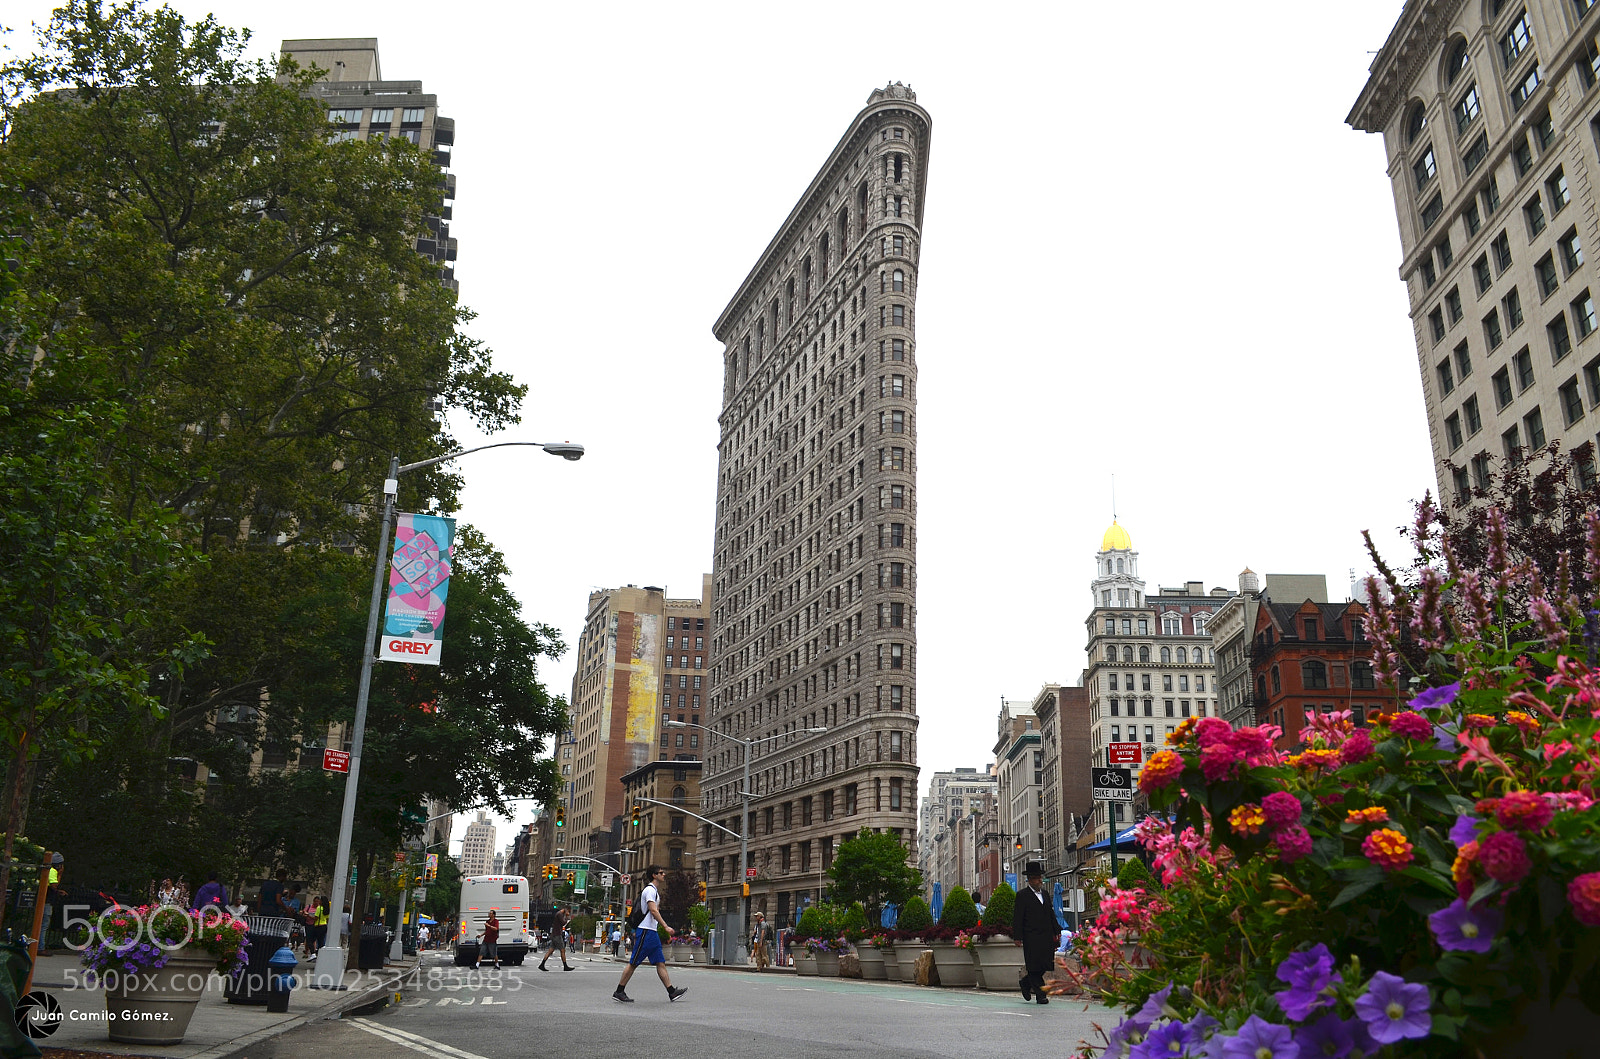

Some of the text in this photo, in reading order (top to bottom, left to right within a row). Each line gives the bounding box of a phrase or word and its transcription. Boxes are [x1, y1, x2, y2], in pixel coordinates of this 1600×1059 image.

[388, 640, 434, 655] GREY
[1095, 789, 1130, 798] BIKE LANE
